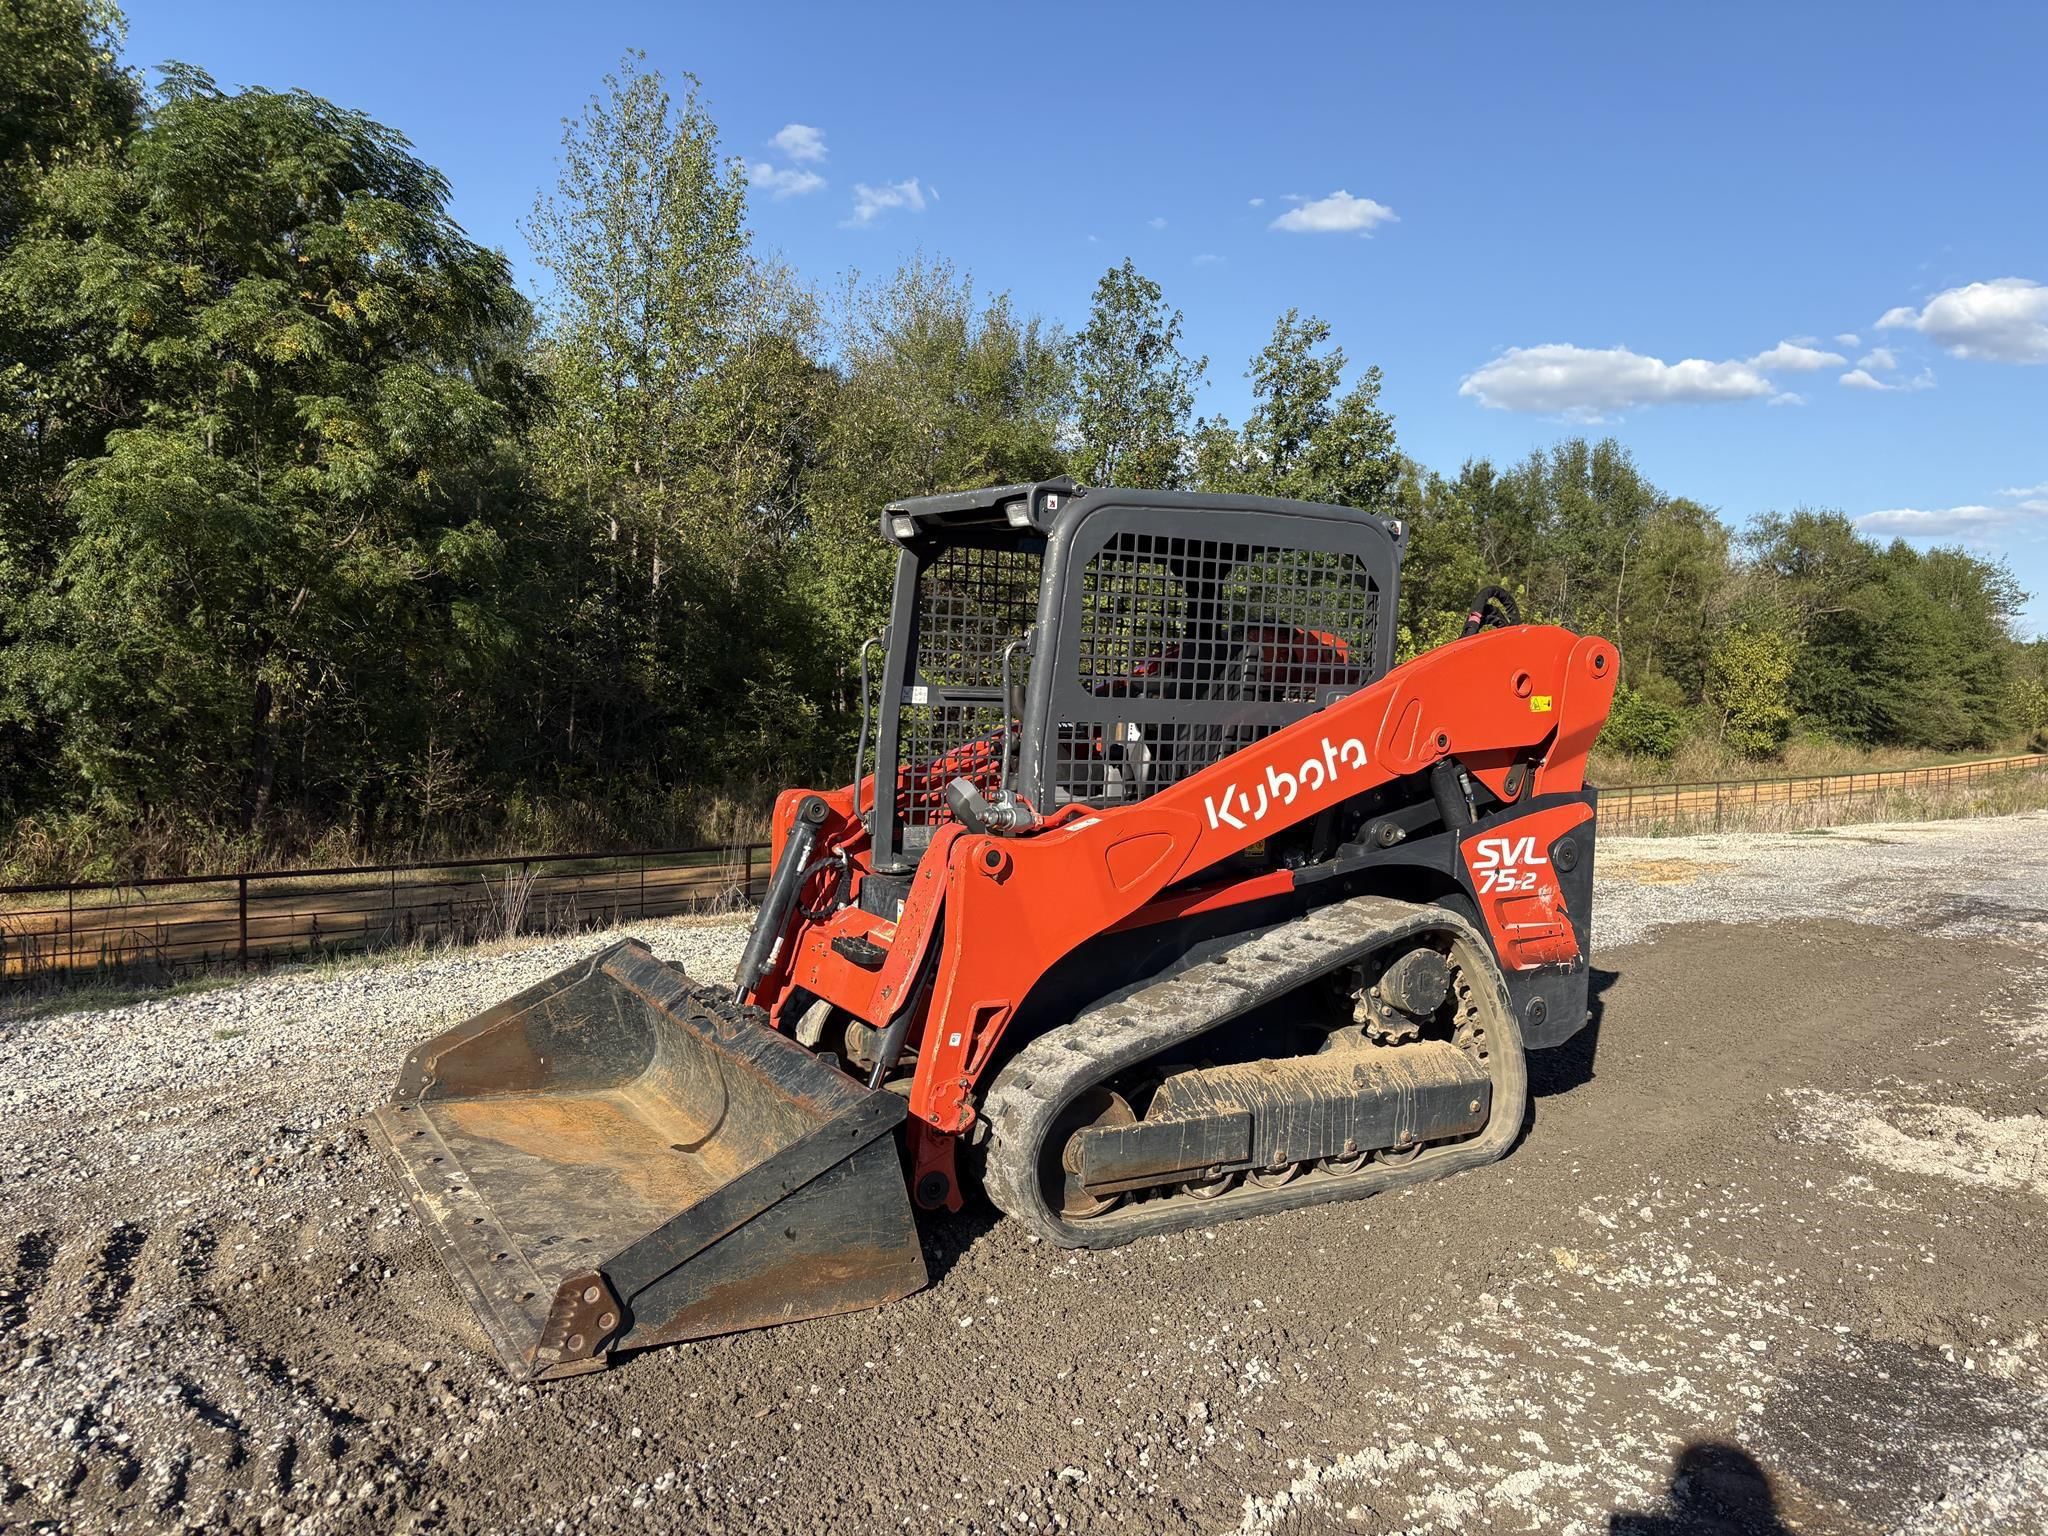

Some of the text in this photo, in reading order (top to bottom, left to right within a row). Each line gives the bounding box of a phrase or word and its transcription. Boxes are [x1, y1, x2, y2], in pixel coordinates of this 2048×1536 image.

[1204, 737, 1367, 830] Kubota
[1472, 837, 1547, 869] SVL
[1479, 869, 1537, 894] 75-2
